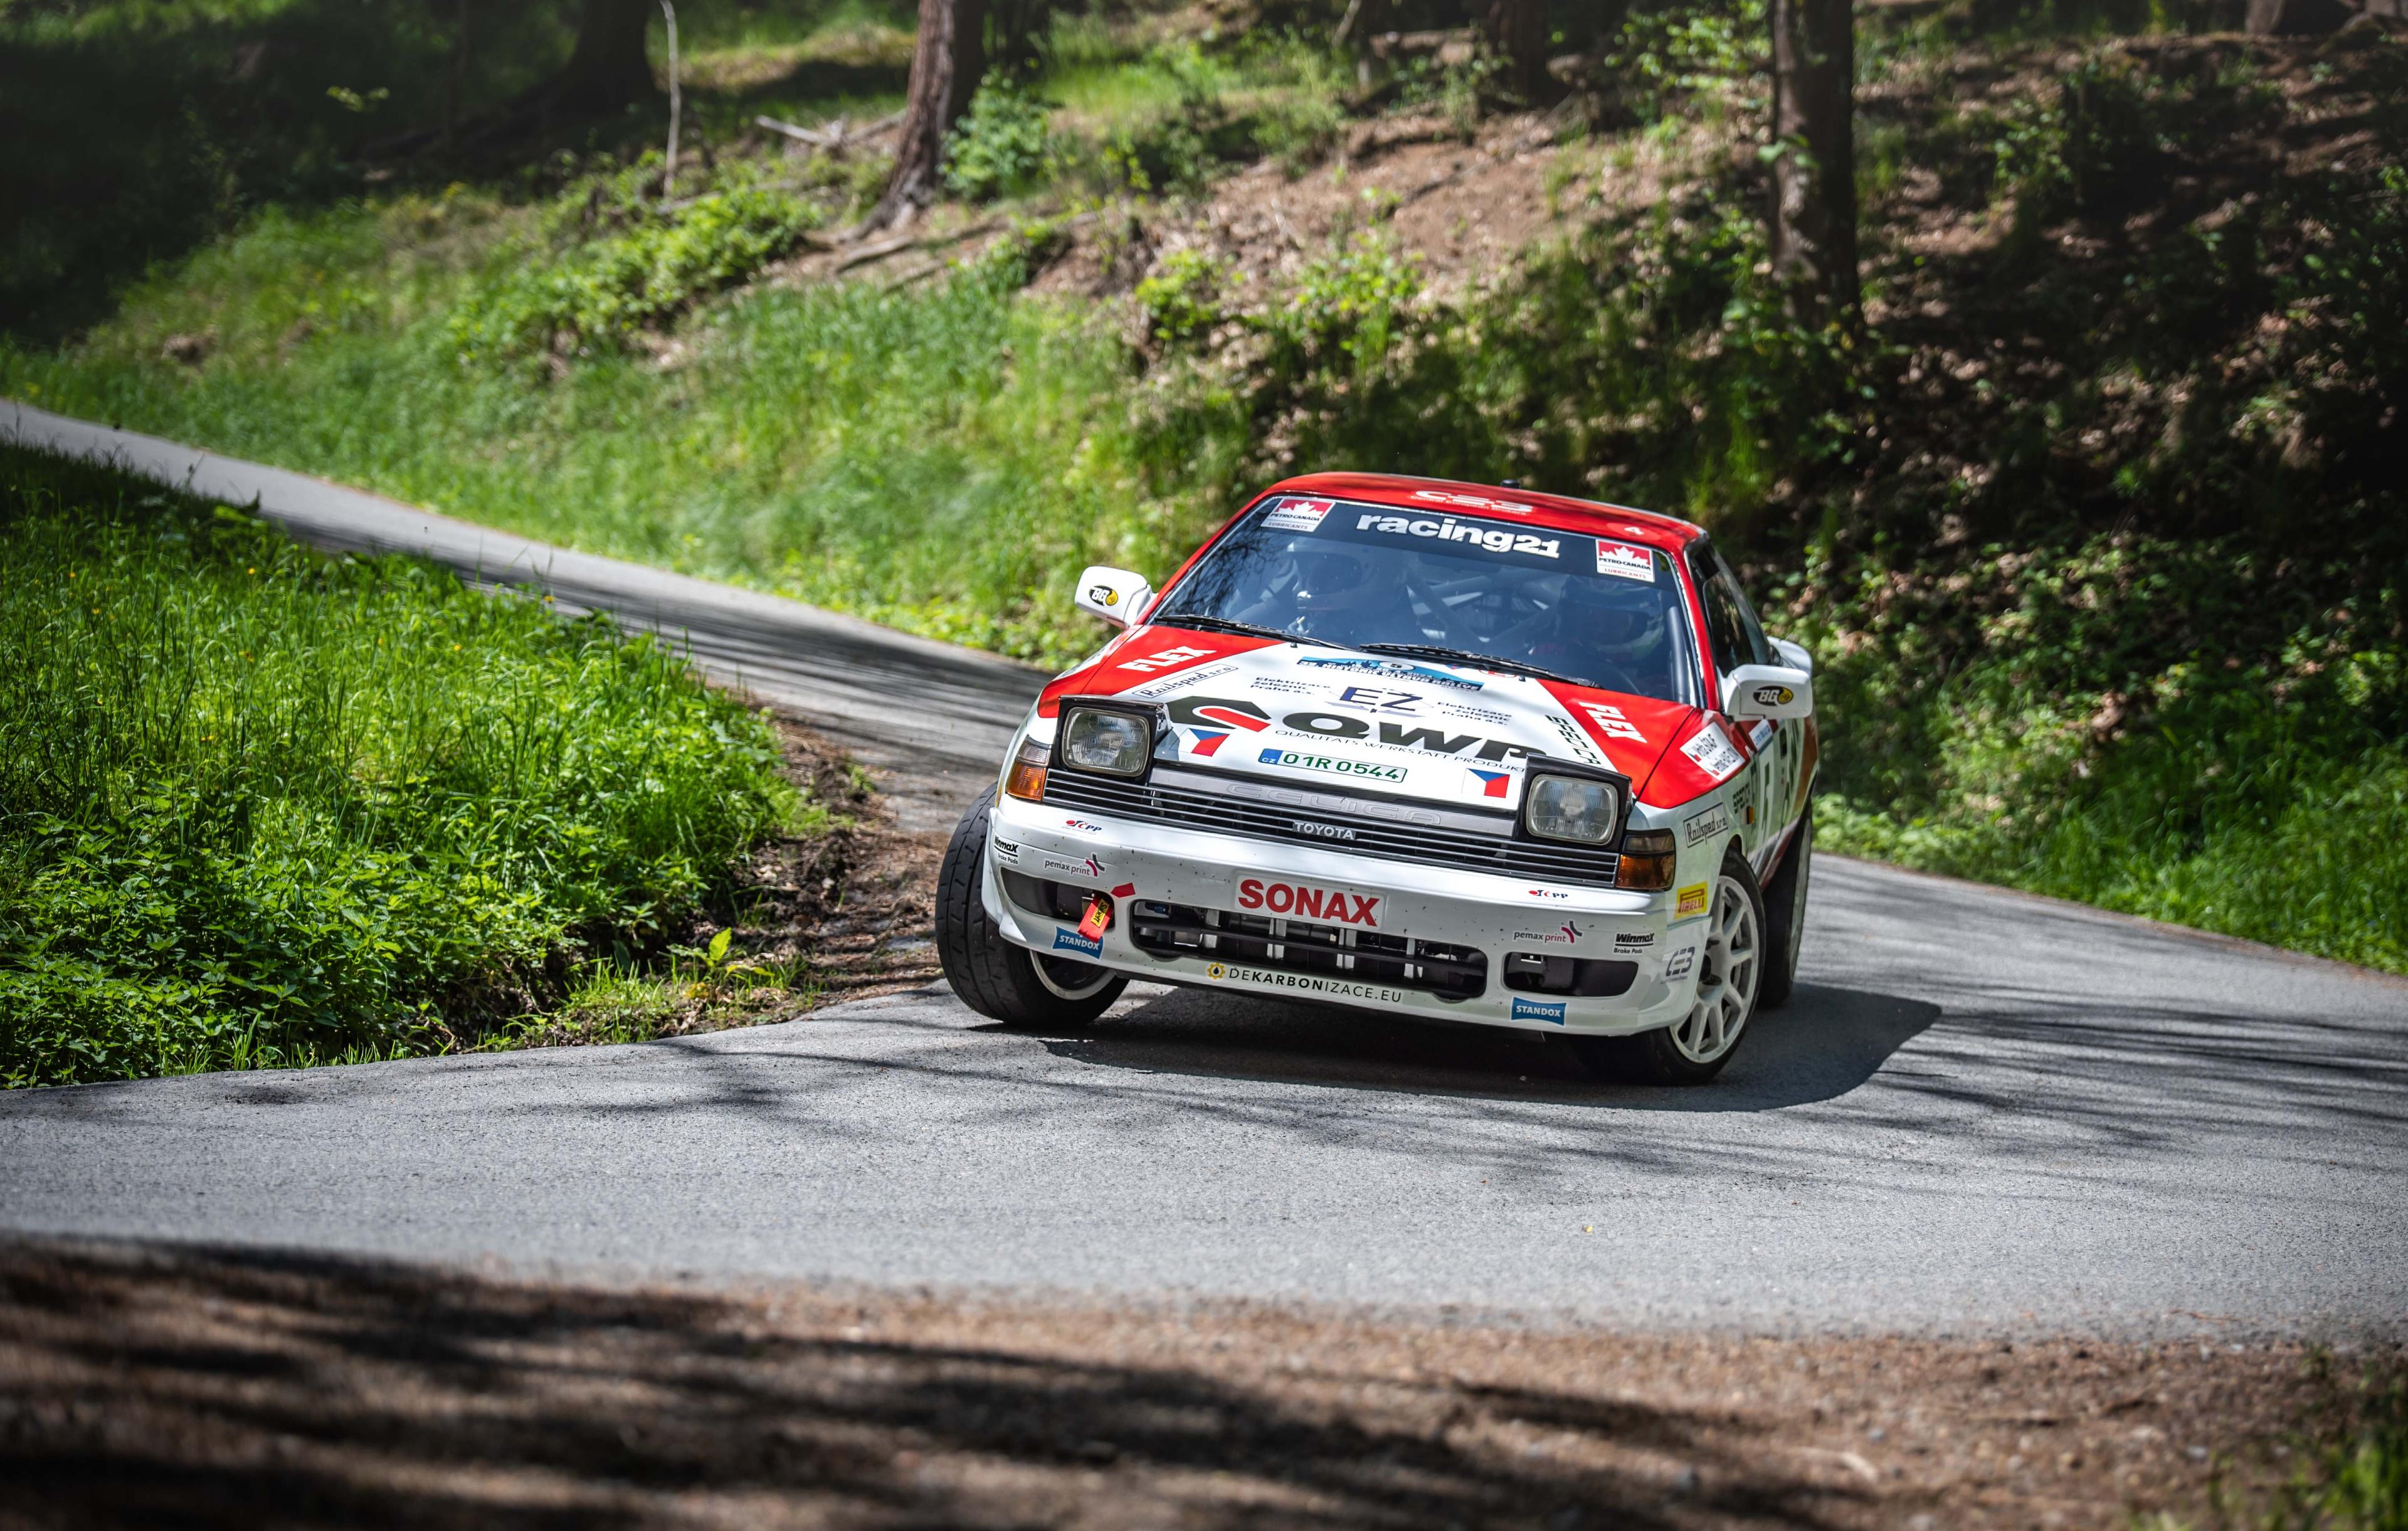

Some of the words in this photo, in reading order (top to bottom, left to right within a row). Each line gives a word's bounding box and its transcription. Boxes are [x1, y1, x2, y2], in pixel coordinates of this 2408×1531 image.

[1268, 522, 1308, 530] LUBRICANTS
[1624, 527, 1644, 536] 4
[1356, 514, 1561, 559] racing21
[1604, 568, 1647, 579] LUBRICANTS
[1090, 587, 1111, 604] BG
[1116, 646, 1217, 672] FLEX
[1140, 673, 1208, 696] Railsped
[1255, 677, 1331, 689] Elektrizace
[1756, 689, 1780, 703] BG
[1437, 702, 1513, 717] Elektrizace
[1442, 711, 1481, 721] Praha
[1578, 701, 1648, 743] FLEX
[1365, 742, 1450, 759] WERKSTATT
[1284, 753, 1332, 769] 01R
[1336, 761, 1400, 780] 0544
[1226, 783, 1441, 825] CELICA
[1295, 822, 1356, 840] TOYOTA
[1686, 812, 1716, 845] Railsped
[1044, 859, 1070, 871] pemax
[1070, 864, 1090, 876] print
[1238, 879, 1380, 926] SONAX
[1677, 888, 1705, 914] PIRELLI
[1059, 935, 1100, 951] STANDOX
[1514, 930, 1543, 940] pemax
[1545, 933, 1566, 943] print
[1229, 968, 1402, 1003] DEKARBONIZACE.EU
[1516, 1005, 1561, 1017] STANDOX
